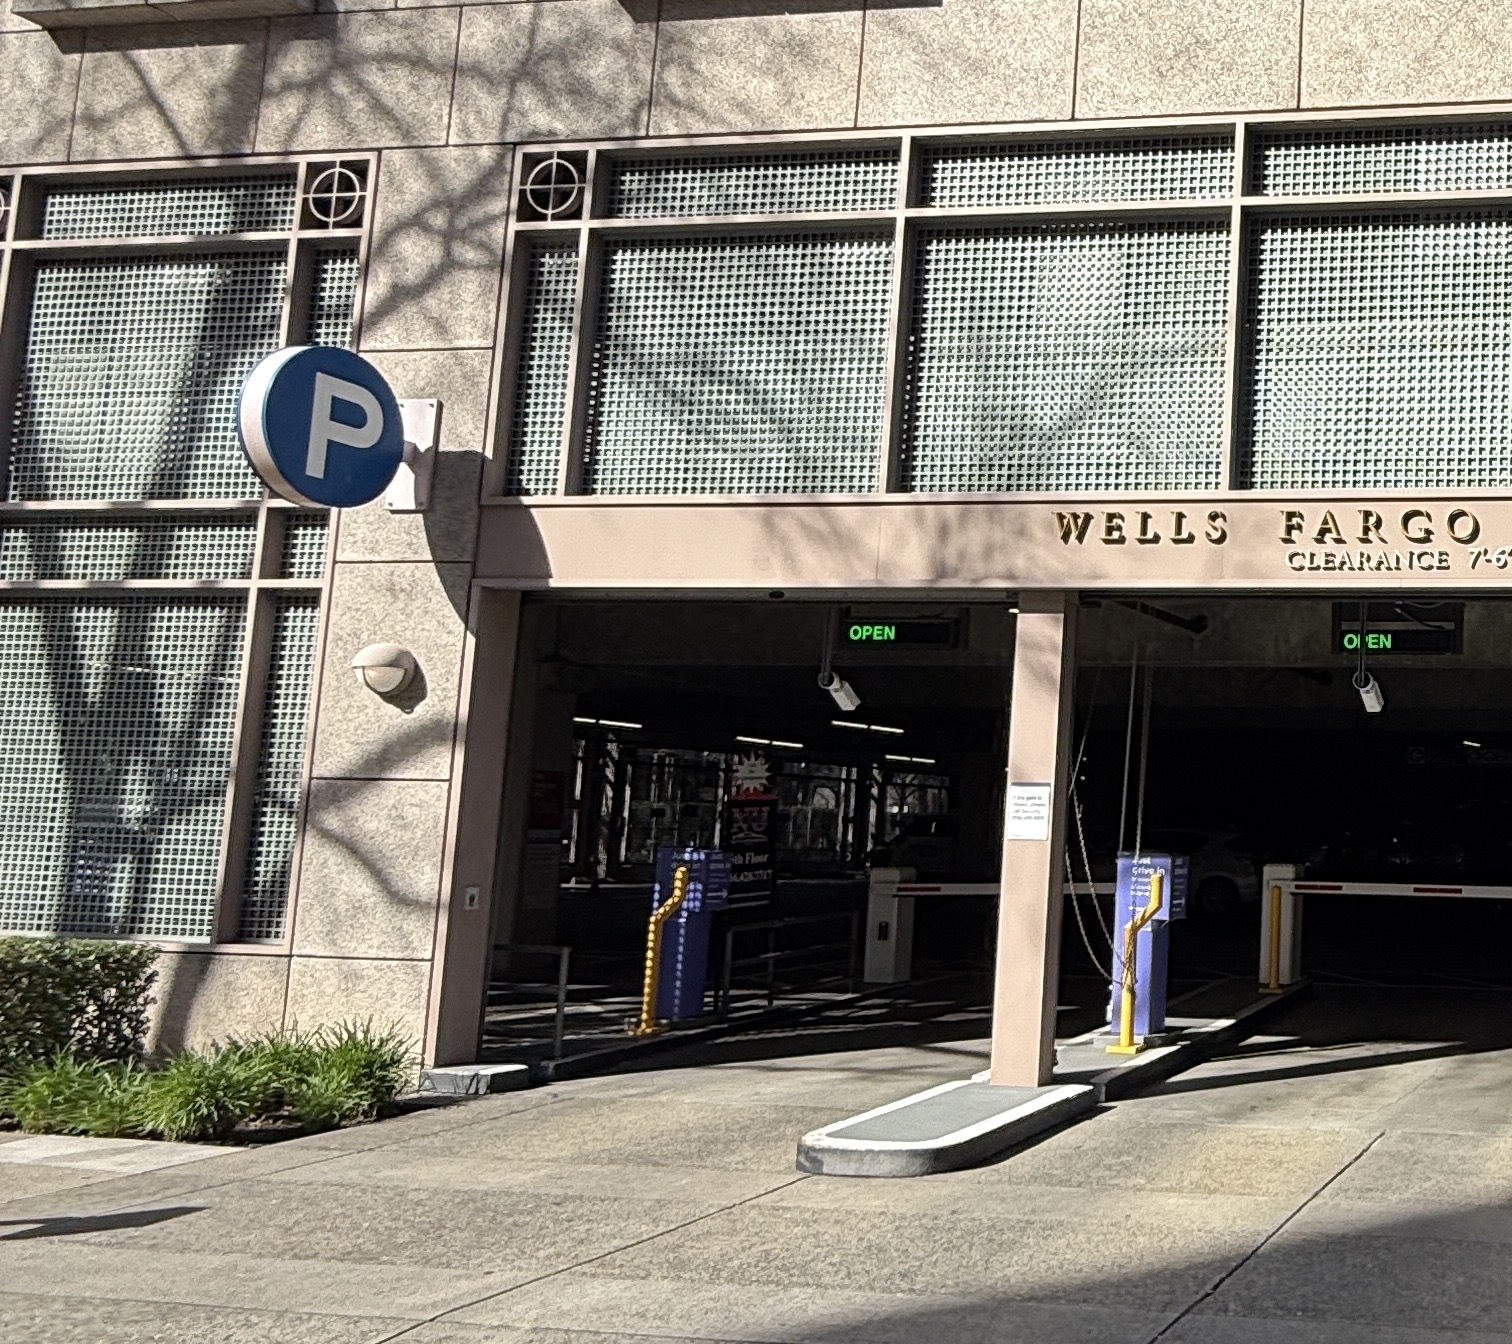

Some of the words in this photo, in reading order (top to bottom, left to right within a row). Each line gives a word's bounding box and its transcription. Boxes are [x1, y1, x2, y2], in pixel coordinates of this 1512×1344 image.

[306, 372, 384, 480] P
[1051, 509, 1229, 545] WELLS
[1279, 508, 1481, 545] FARGO
[1286, 550, 1451, 572] CLEARANCE
[849, 625, 896, 641] OPEN
